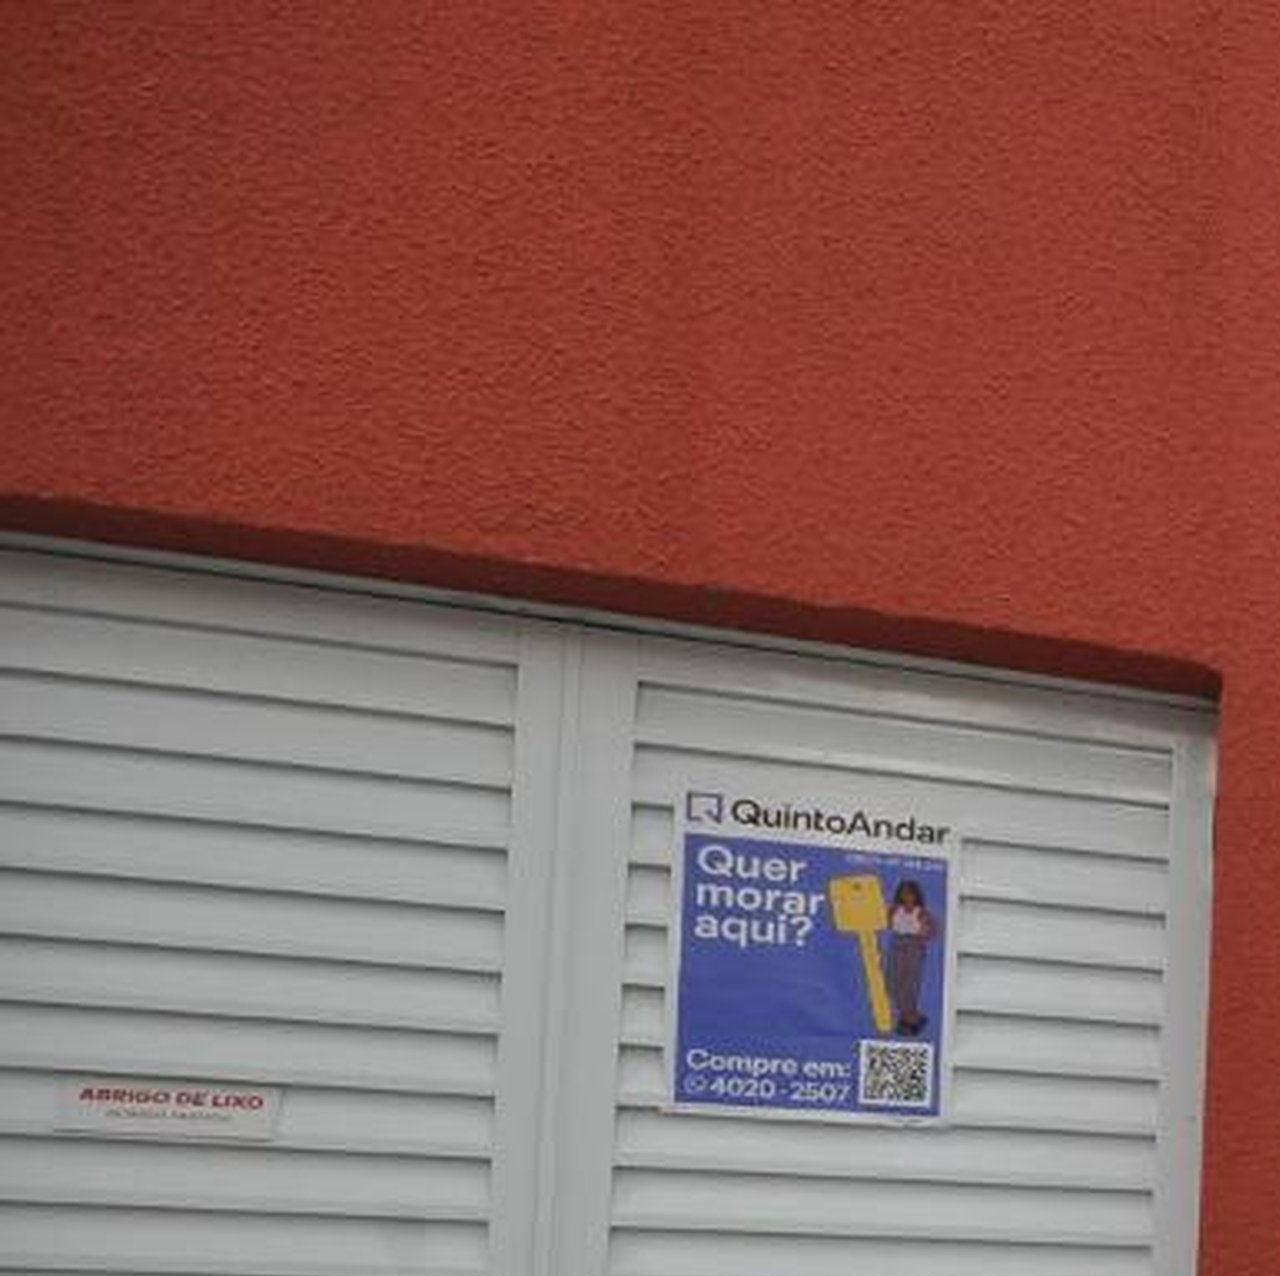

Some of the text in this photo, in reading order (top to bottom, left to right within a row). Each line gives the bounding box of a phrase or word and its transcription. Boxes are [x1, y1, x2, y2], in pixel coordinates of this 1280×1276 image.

[730, 799, 950, 844] QuintoAndar
[698, 846, 806, 882] Quer
[696, 884, 825, 915] morar
[694, 916, 813, 946] aqui?
[686, 1050, 850, 1077] Compre em:
[79, 1088, 264, 1110] ABRIGO DE LIXO
